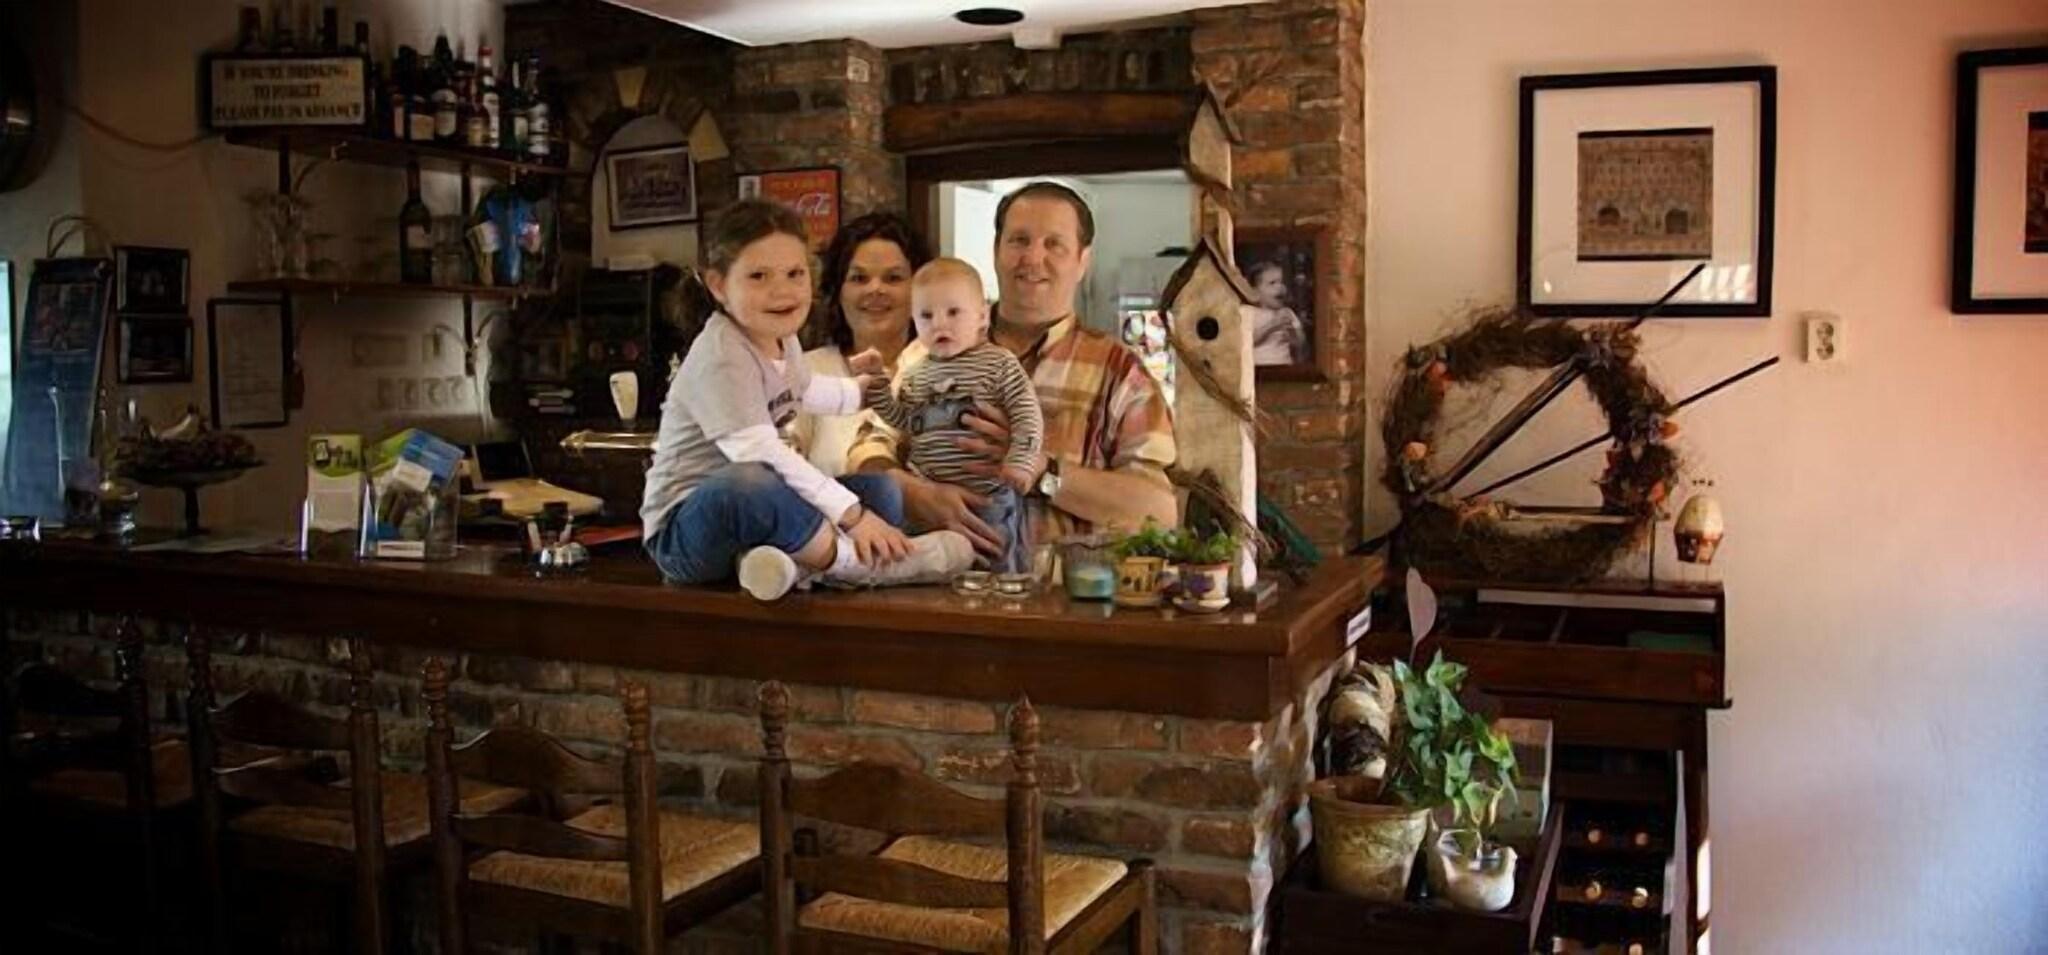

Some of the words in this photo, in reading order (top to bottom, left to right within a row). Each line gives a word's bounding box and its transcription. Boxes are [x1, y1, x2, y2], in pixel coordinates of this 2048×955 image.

[254, 84, 270, 99] TO
[271, 83, 321, 98] FORGET
[215, 104, 259, 120] PLEASE
[262, 104, 285, 119] PAY
[305, 102, 361, 118] ADVANCE
